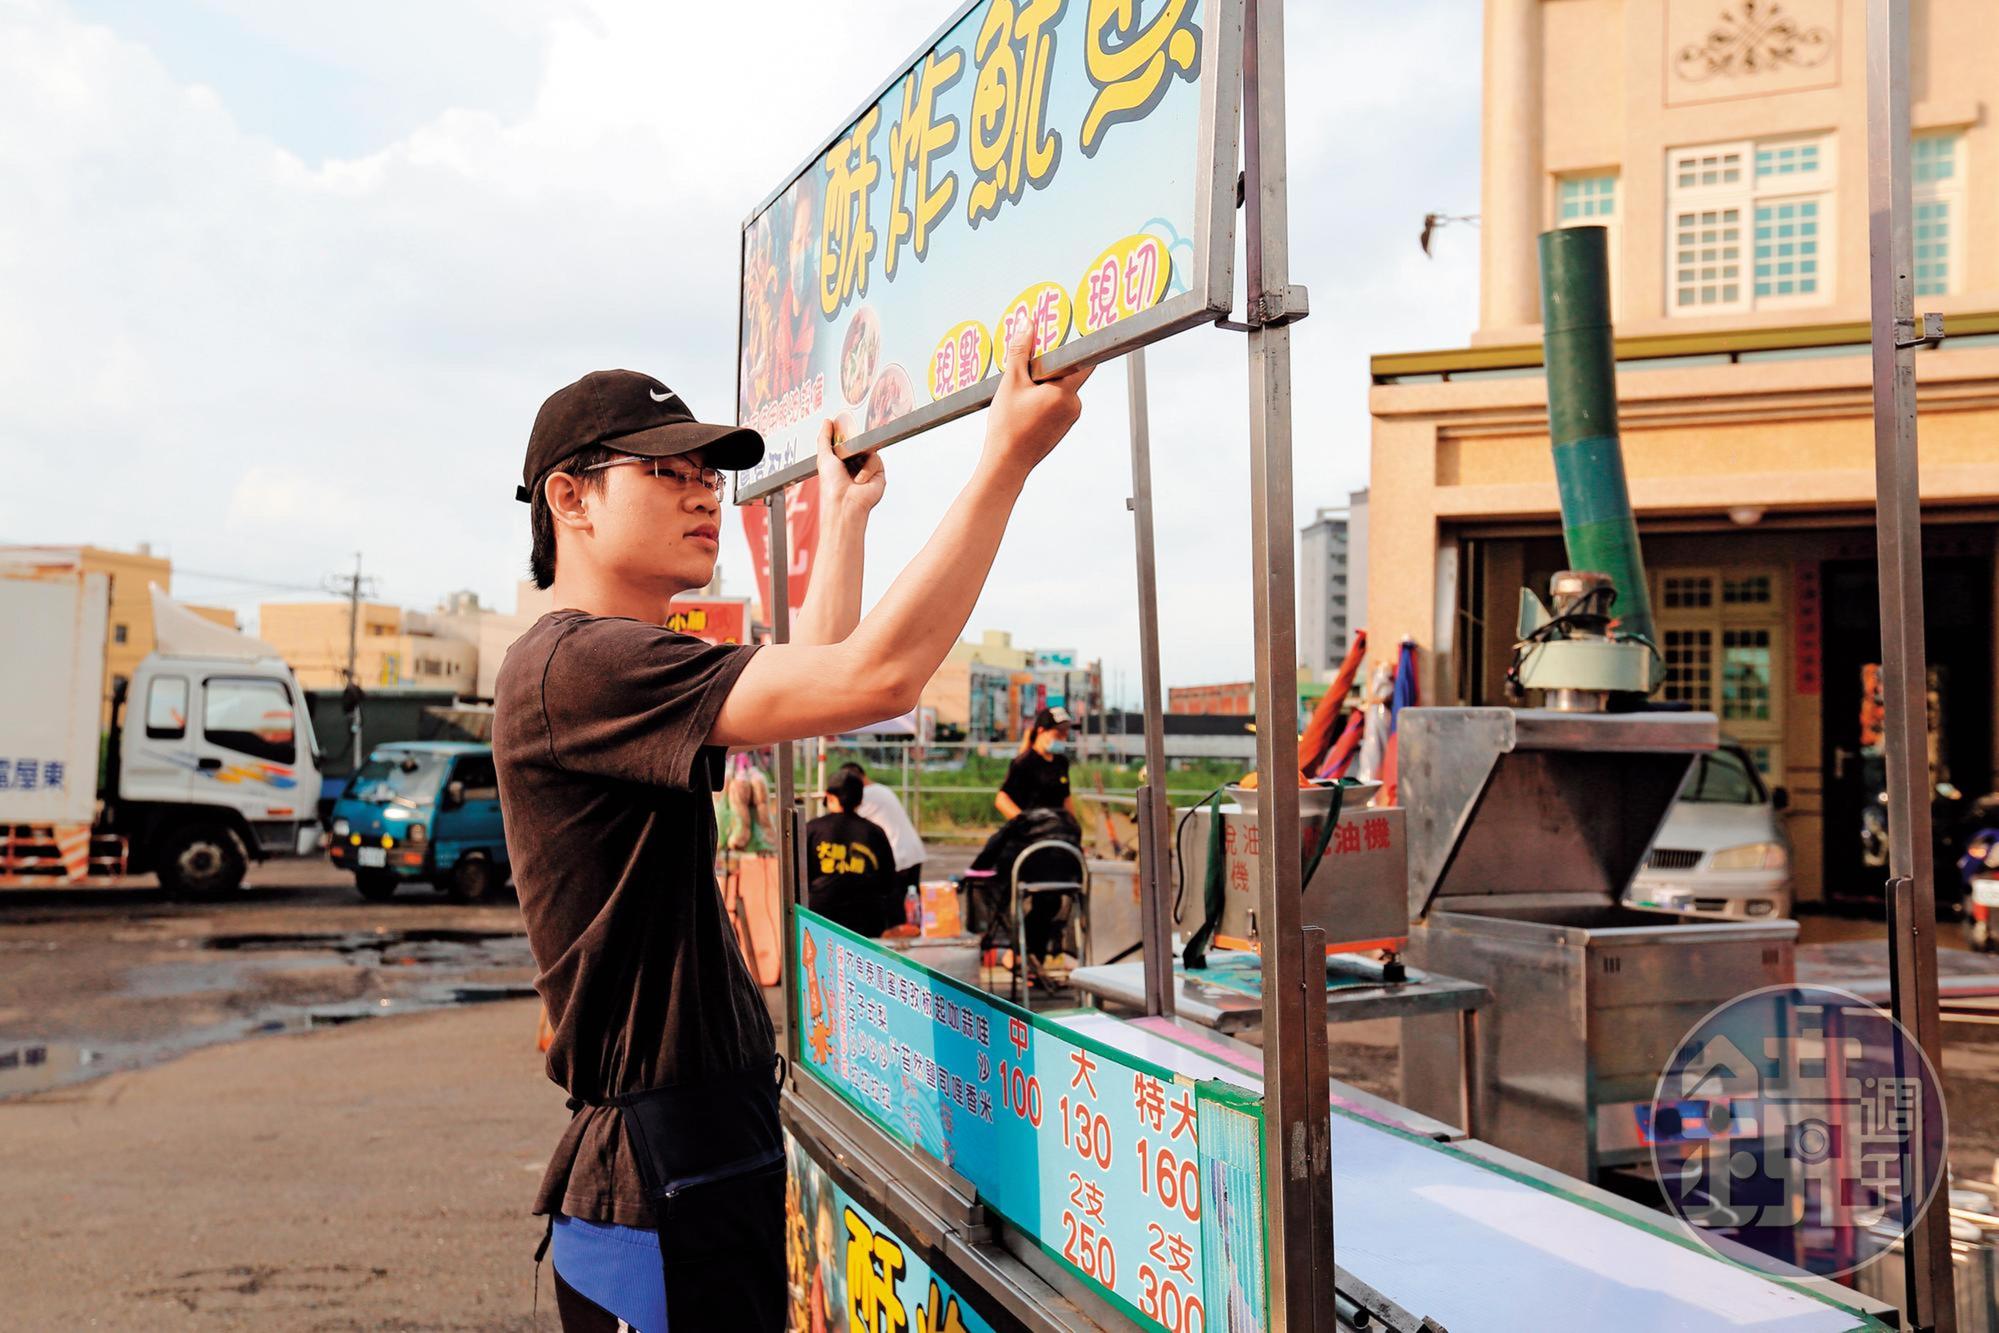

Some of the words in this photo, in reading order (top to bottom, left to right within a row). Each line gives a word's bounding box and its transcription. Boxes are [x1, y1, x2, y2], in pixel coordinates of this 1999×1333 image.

[1088, 243, 1157, 327] 現切
[934, 327, 980, 395] 現點
[934, 994, 949, 1098] 起司
[961, 1008, 977, 1115] 蒜香
[976, 1016, 993, 1123] 哇沙米
[1009, 1018, 1029, 1059] 中
[1071, 1049, 1097, 1099] 大
[1000, 1061, 1042, 1129] 100
[1134, 1072, 1198, 1145] 特大
[1060, 1096, 1112, 1170] 130
[1069, 1172, 1105, 1226] 2支
[1137, 1138, 1200, 1222] 160
[1063, 1210, 1116, 1292] 250
[1148, 1223, 1194, 1285] 2支
[1139, 1264, 1205, 1333] 300
